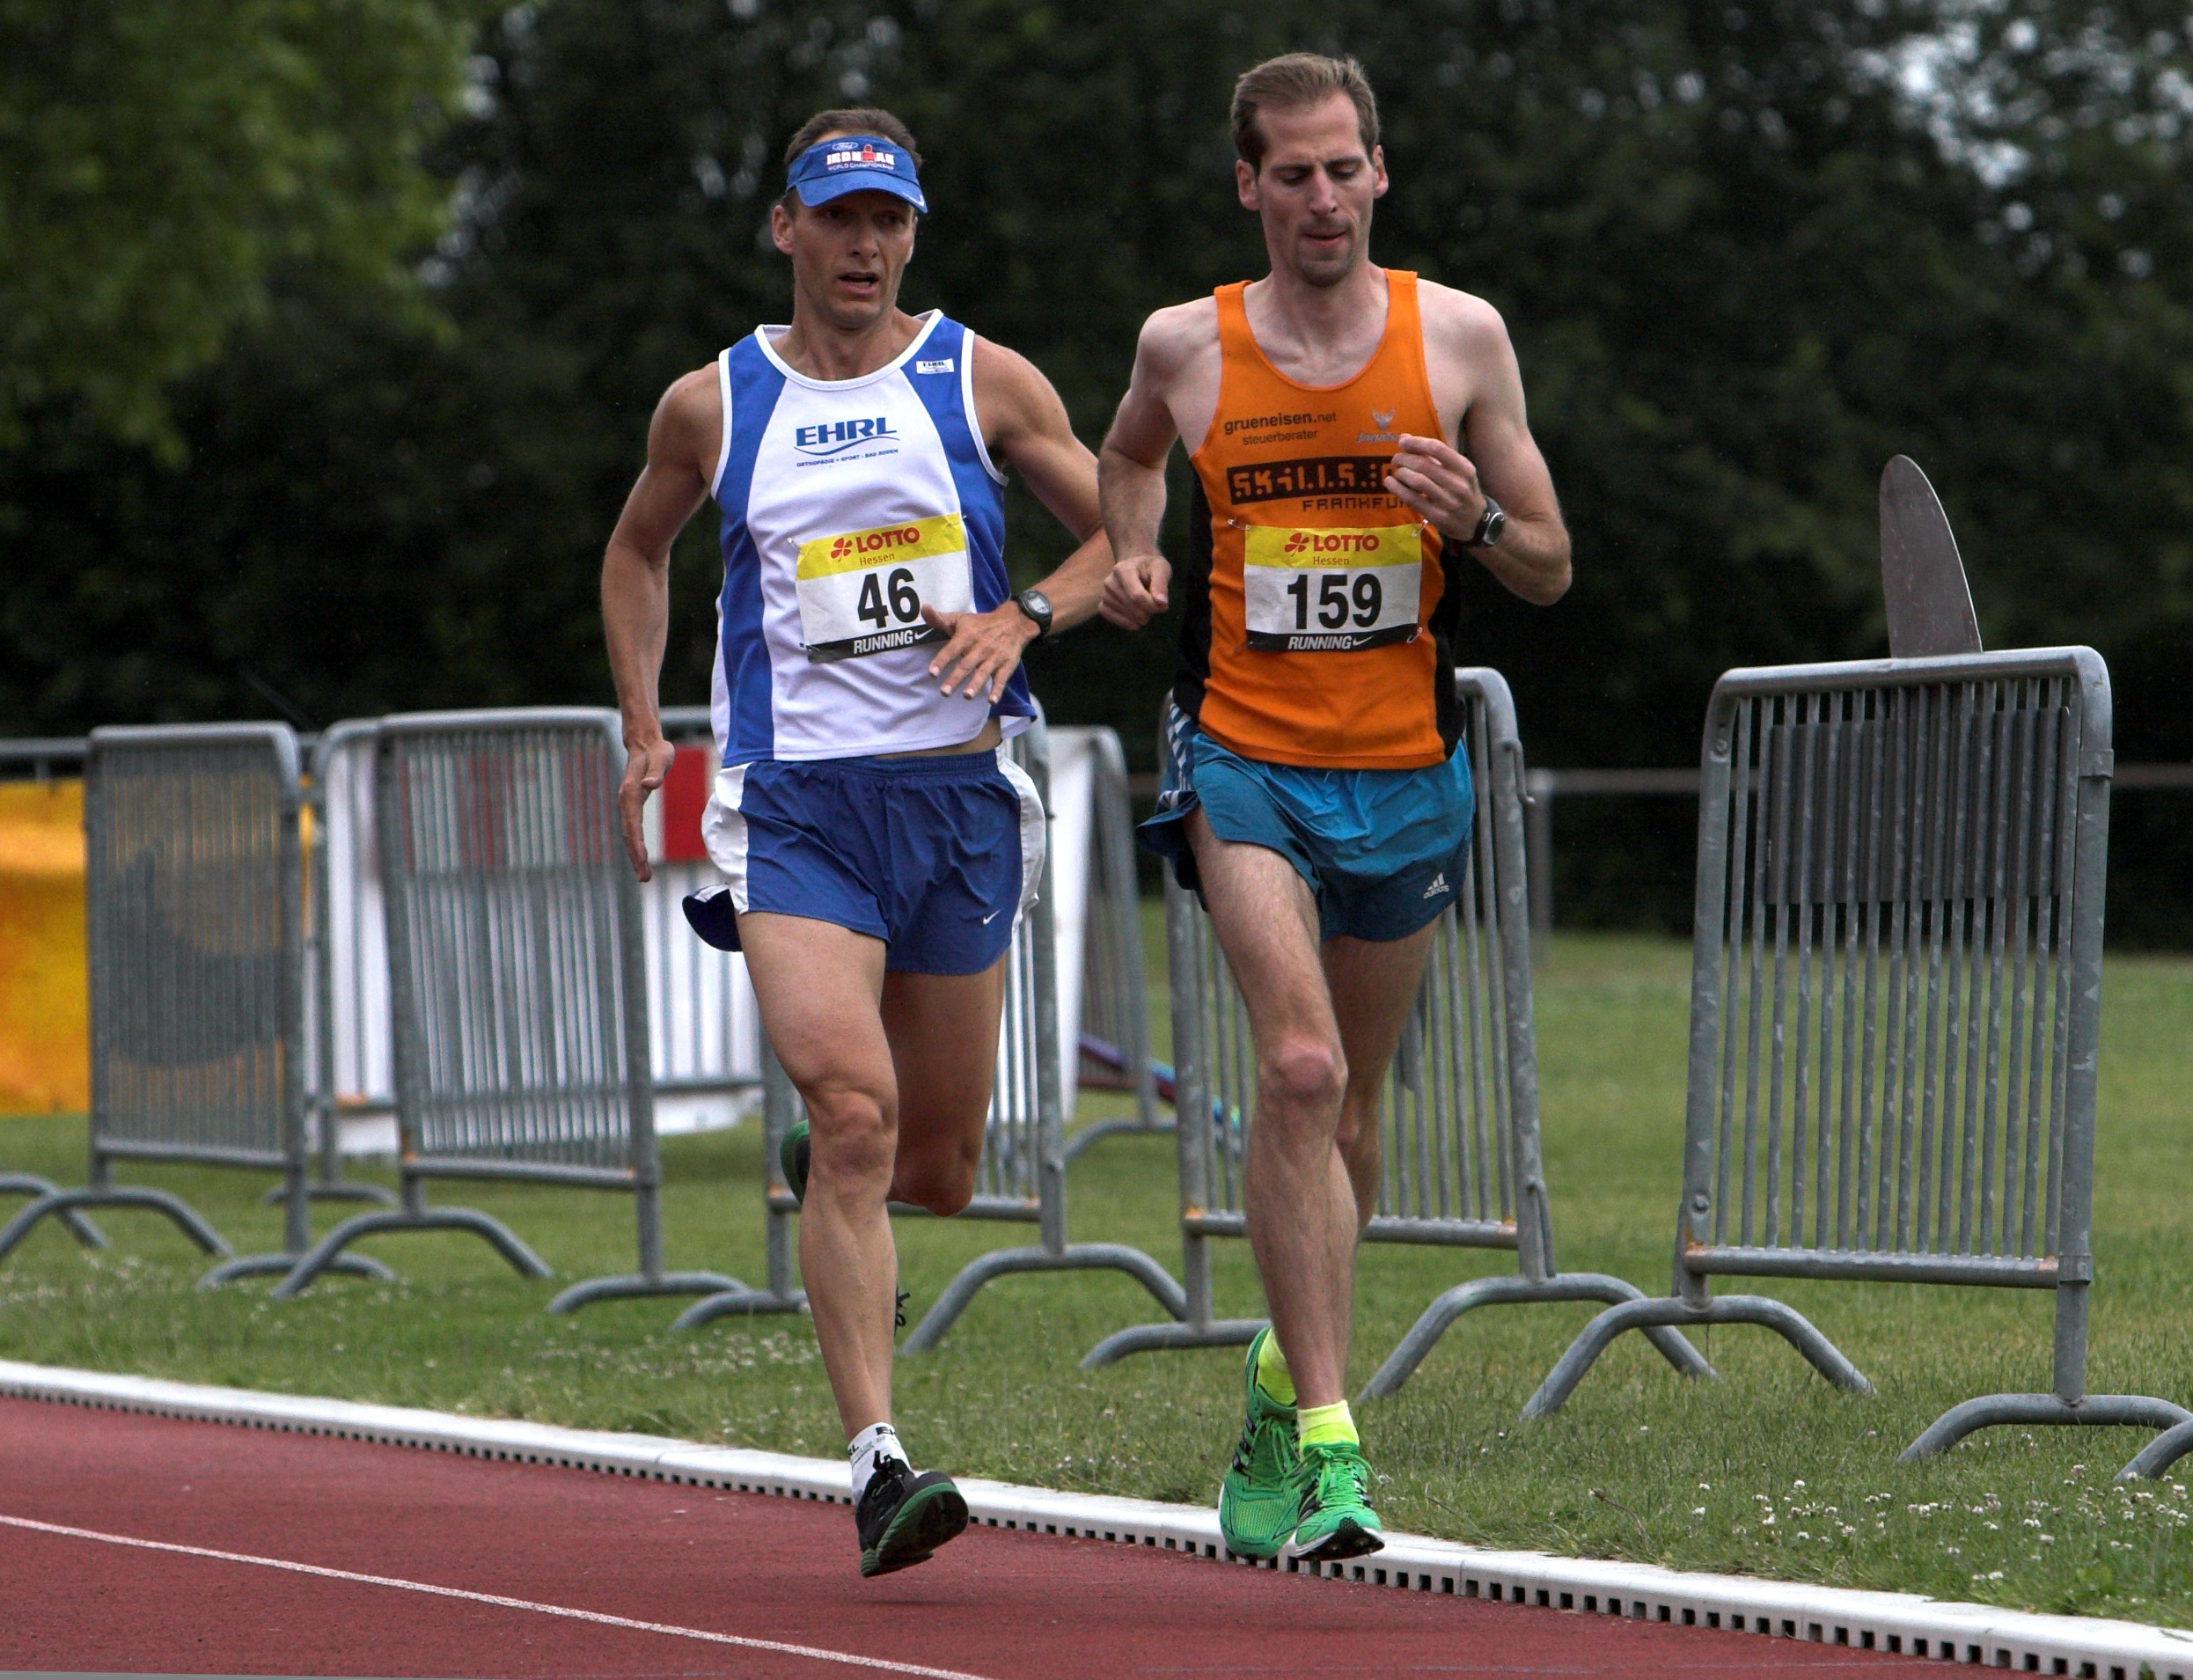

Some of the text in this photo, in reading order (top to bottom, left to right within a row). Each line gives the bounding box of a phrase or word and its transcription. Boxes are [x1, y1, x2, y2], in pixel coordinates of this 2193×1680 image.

[796, 417, 898, 447] EHRL
[1223, 411, 1338, 436] grueneisen.net
[1243, 429, 1319, 445] steuerberater
[1302, 496, 1408, 513] FRANKFU
[855, 526, 920, 554] LOTTO
[1312, 534, 1380, 553] LOTTO
[859, 553, 895, 567] Hessen
[1312, 556, 1350, 566] Hessen
[856, 568, 920, 629] 46
[1287, 573, 1383, 630] 159
[853, 629, 914, 655] RUNNING
[1287, 635, 1353, 650] RUNNING
